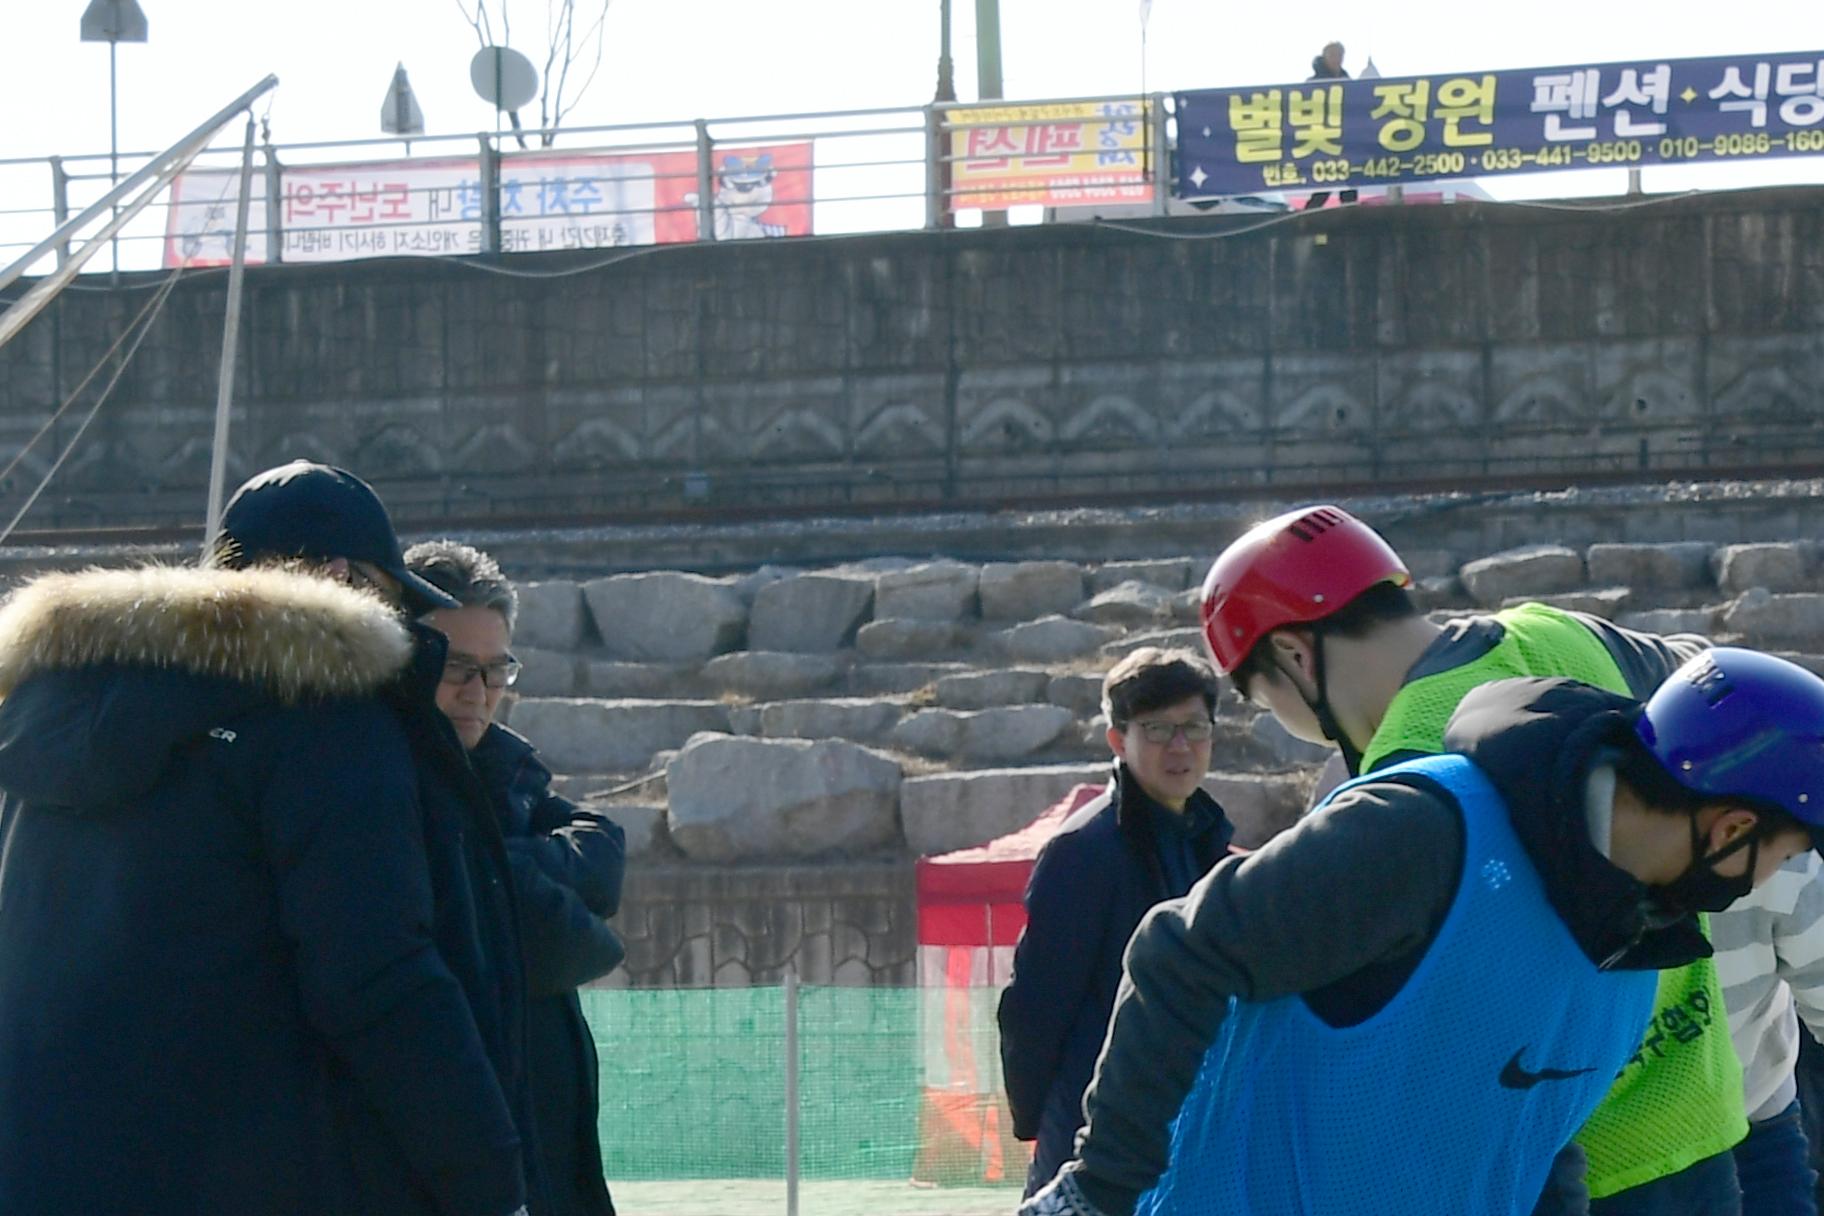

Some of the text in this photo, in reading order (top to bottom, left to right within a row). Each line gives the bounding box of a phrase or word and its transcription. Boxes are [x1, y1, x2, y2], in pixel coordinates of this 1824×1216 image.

[1229, 86, 1342, 162] 별빛
[1370, 75, 1497, 152] 정원
[1530, 64, 1671, 142] 펜션
[1312, 152, 1465, 183] 033-442-2500
[1482, 141, 1641, 170] 033-441-9500
